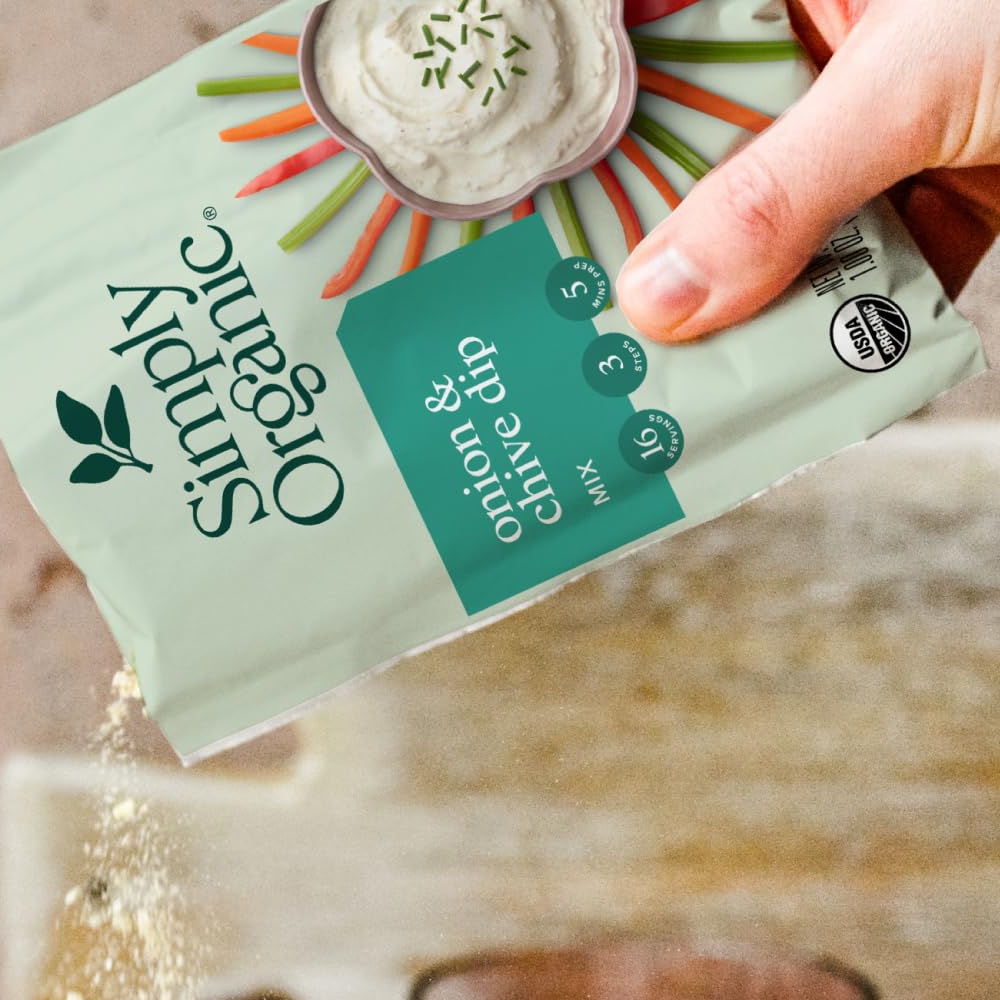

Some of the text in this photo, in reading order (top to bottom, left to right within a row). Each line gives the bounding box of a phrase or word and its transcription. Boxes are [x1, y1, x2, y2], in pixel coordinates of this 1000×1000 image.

[574, 261, 605, 309] MINS PREP
[840, 247, 878, 281] 1.00
[560, 281, 588, 299] 5
[844, 316, 875, 360] USDA
[862, 303, 896, 355] ORGANIC
[598, 354, 624, 375] 3
[622, 340, 642, 372] STEPS
[106, 284, 270, 538] Simply
[457, 336, 562, 525] chive dip
[425, 374, 522, 543] onion &
[633, 427, 664, 461] 16
[648, 413, 679, 459] SERVINGS
[576, 458, 611, 506] MIX
